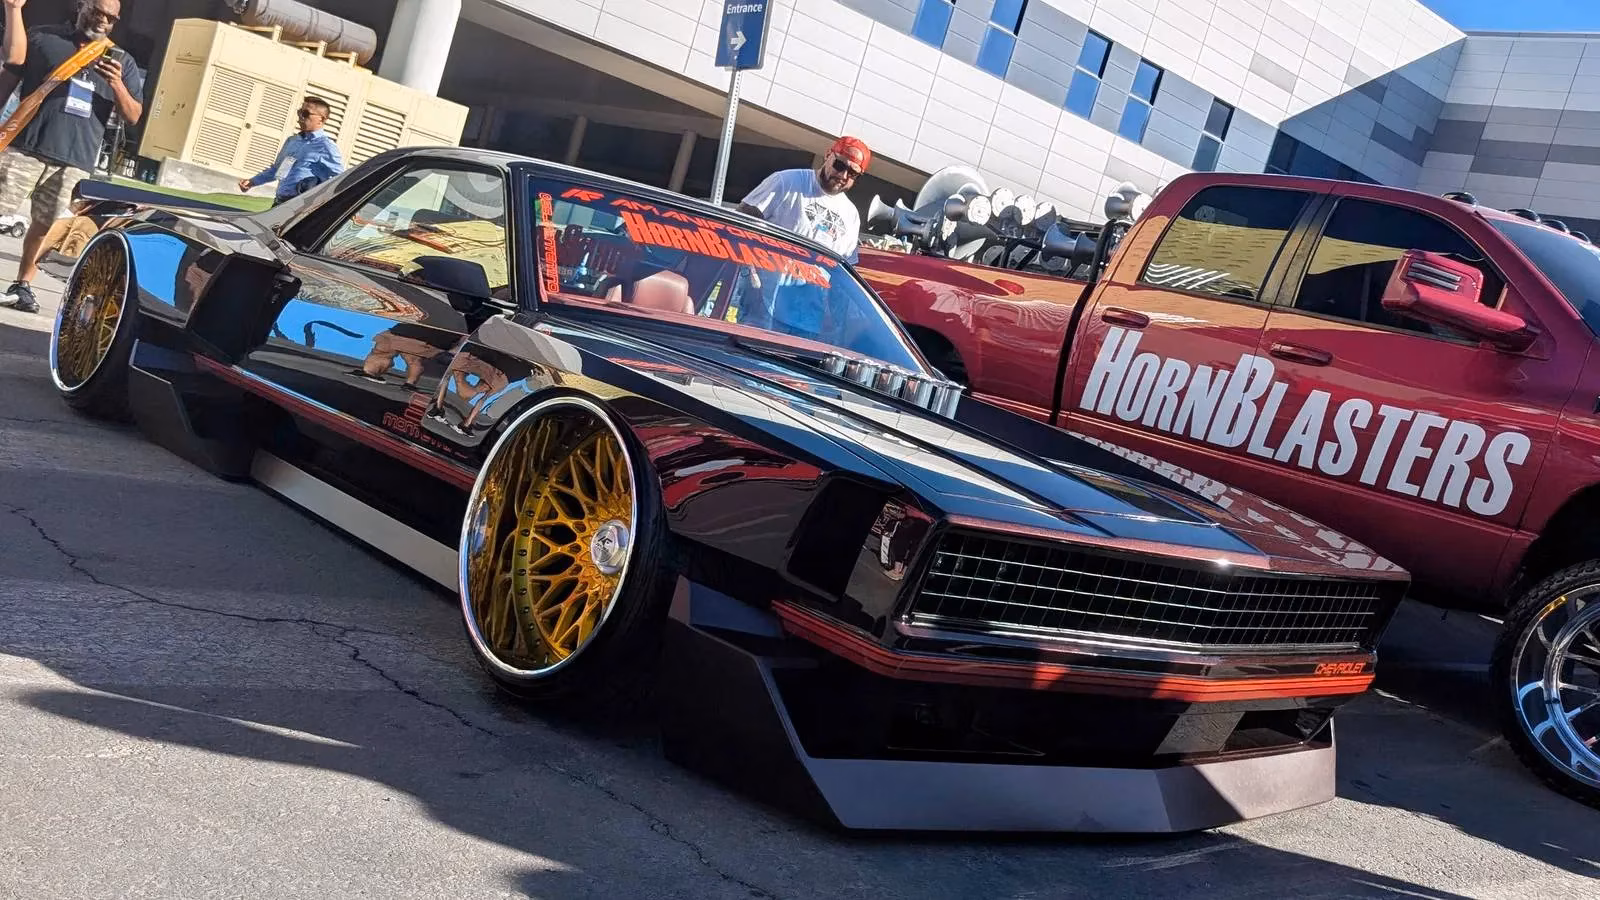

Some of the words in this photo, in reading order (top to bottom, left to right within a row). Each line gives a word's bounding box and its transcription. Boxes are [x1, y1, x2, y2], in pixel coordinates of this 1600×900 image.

[726, 3, 763, 14] Entrance
[1078, 326, 1531, 516] HORNBLASTERS
[1315, 661, 1366, 675] CHEVROLET
